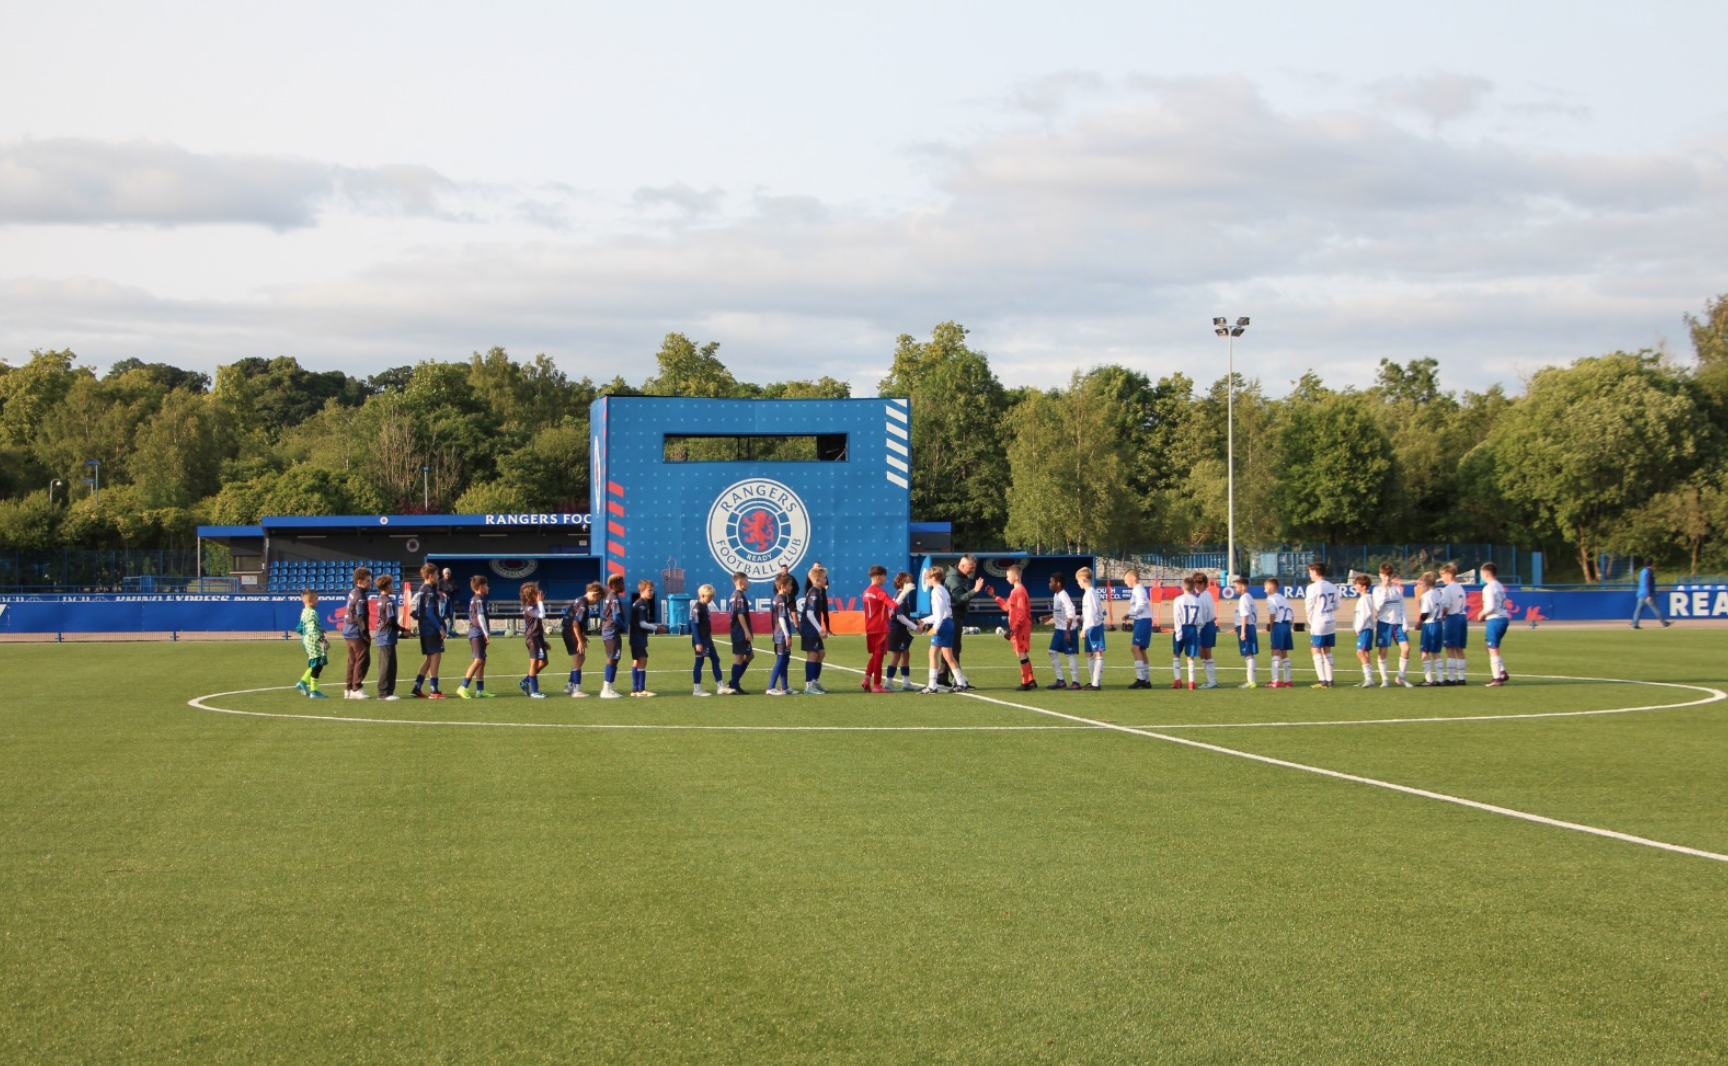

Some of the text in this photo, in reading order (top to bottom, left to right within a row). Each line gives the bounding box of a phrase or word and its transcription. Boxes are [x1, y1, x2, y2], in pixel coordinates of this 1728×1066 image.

[720, 485, 797, 512] RANGERS
[485, 514, 558, 525] RANGERS
[716, 538, 802, 576] FOOTBALL CLUB
[746, 553, 773, 562] READY
[1284, 586, 1358, 598] RARS
[1183, 604, 1200, 625] 17
